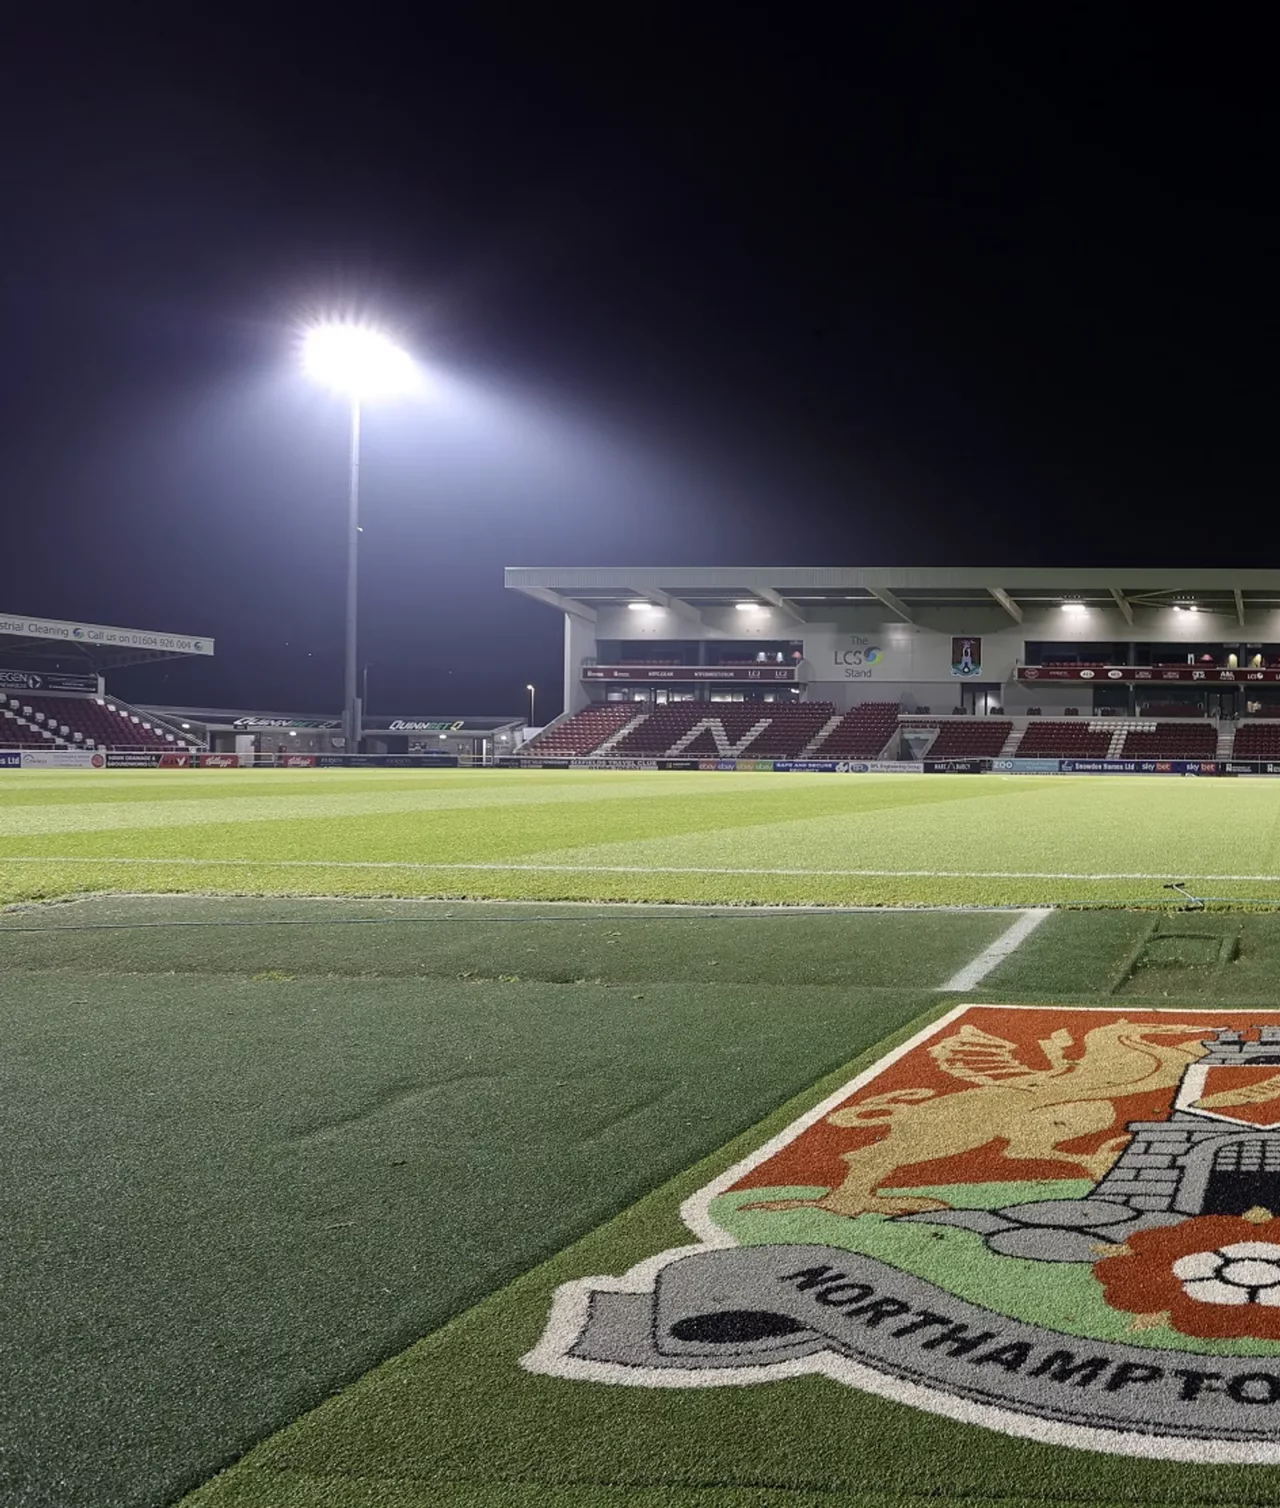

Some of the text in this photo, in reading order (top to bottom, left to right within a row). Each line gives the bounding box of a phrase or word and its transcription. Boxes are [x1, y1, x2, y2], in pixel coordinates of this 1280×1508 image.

[28, 624, 69, 638] Cleaning
[87, 631, 104, 640] Call
[132, 636, 157, 646] 01604
[851, 637, 869, 647] The
[834, 651, 862, 665] LCS
[845, 669, 872, 680] Stand
[388, 720, 452, 731] QUINNBET
[7, 757, 20, 765] Ltd
[994, 761, 1013, 769] ZOO
[699, 763, 717, 771] ebay
[717, 763, 735, 771] ebay
[736, 763, 754, 771] ebay
[755, 763, 774, 772] ebay
[1142, 763, 1155, 772] sky
[1187, 763, 1200, 772] sky
[1201, 763, 1216, 771] bet
